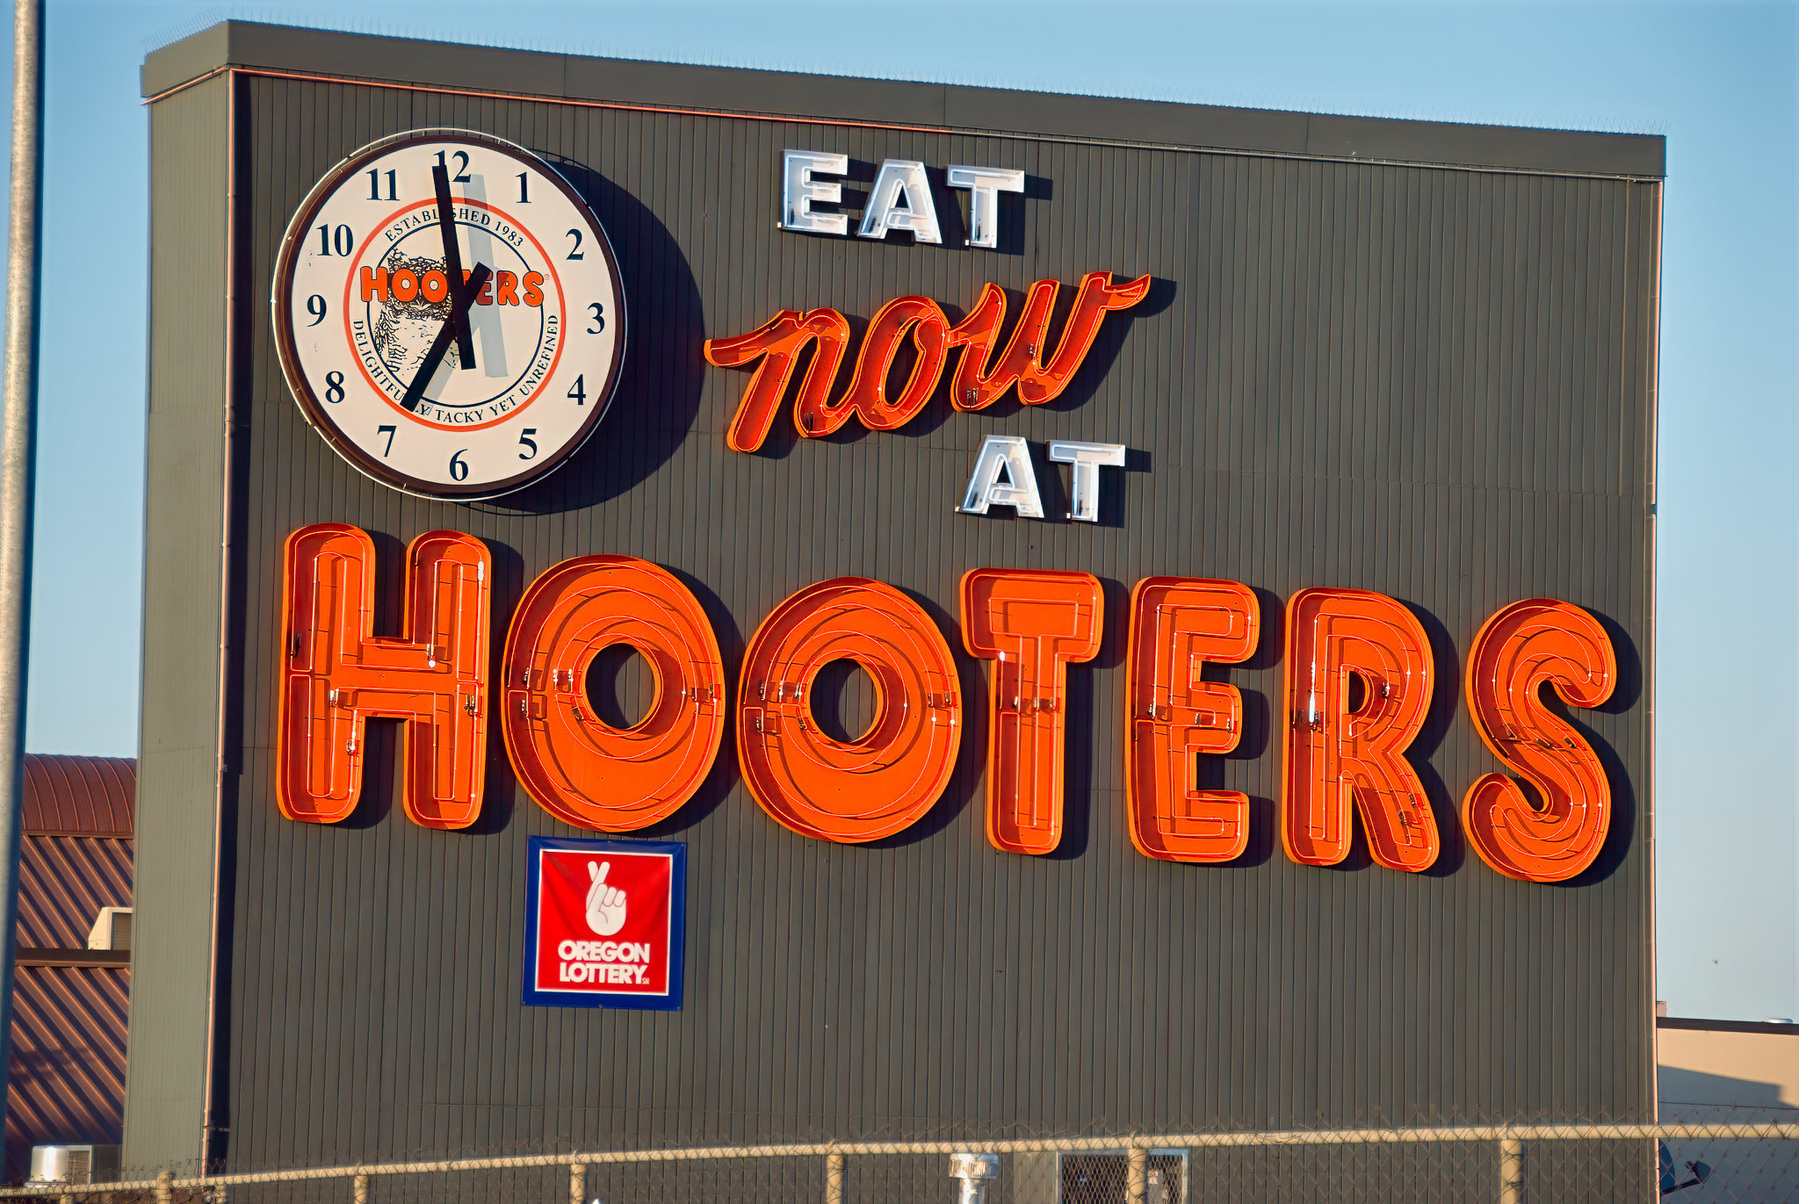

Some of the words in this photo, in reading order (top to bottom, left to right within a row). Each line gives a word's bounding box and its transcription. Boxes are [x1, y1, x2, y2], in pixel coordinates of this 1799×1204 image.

[366, 169, 400, 201] 11
[516, 172, 532, 203] 1
[782, 149, 1025, 248] EAT
[316, 224, 353, 257] 10
[385, 207, 490, 241] ESTABLSHED
[495, 221, 523, 247] 1983
[566, 229, 584, 260] 2
[307, 295, 327, 327] 9
[587, 303, 605, 334] 3
[354, 321, 430, 415] DELIGHTFUY
[435, 409, 484, 423] TACKY
[490, 394, 516, 416] YET
[519, 315, 558, 396] UNREFINED
[704, 271, 1151, 452] now
[325, 371, 345, 403] 8
[567, 374, 586, 405] 4
[377, 426, 397, 457] 7
[519, 428, 537, 460] 5
[449, 449, 468, 481] 6
[959, 435, 1126, 522] AT
[276, 522, 1616, 882] HOOTERS
[557, 939, 650, 963] OREGON
[559, 962, 648, 985] LOTTERY
